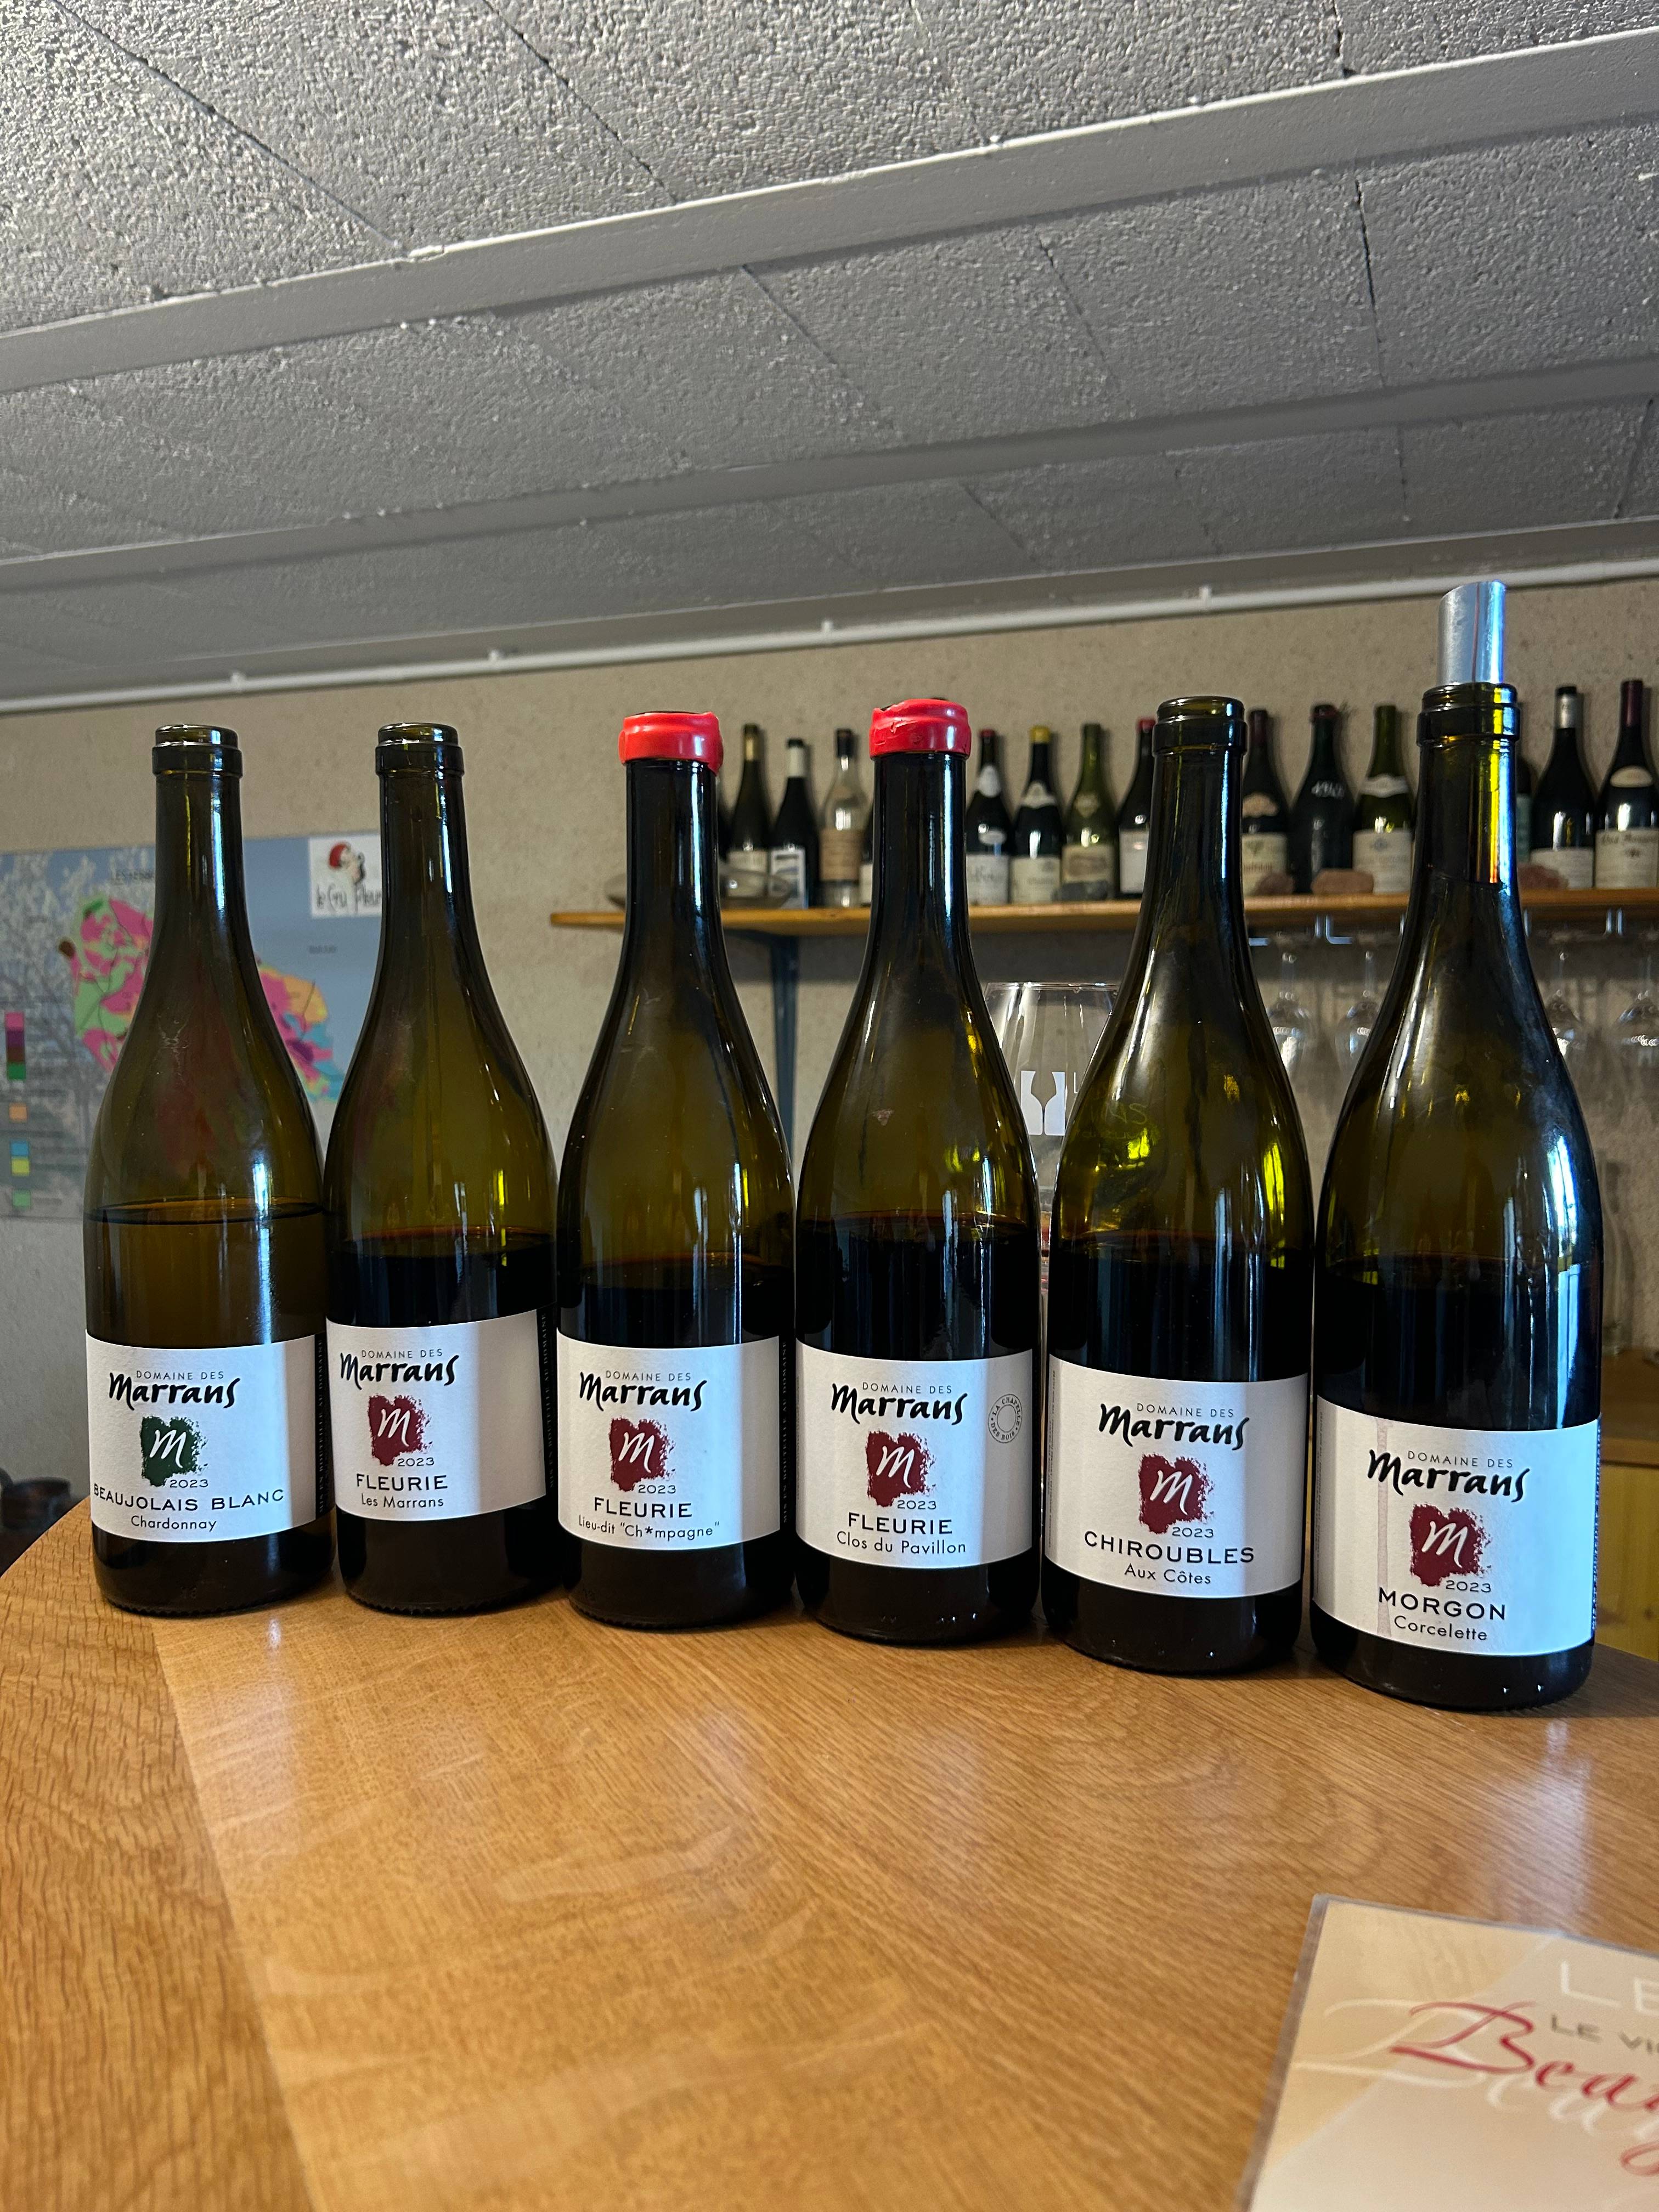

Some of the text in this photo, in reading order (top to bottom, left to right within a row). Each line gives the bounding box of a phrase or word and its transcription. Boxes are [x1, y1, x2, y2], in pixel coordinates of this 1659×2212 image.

[362, 1348, 442, 1359] DOMAINE DES
[136, 1370, 224, 1380] DOMAINE DES
[340, 1352, 459, 1389] Marrans
[605, 1371, 691, 1381] DOMAINE DES
[109, 1373, 240, 1410] Marrans
[579, 1372, 707, 1412] Marrans
[862, 1382, 952, 1394] DOMAINE DES
[831, 1384, 968, 1425] Marrans
[992, 1397, 1021, 1426] LA CHAPELLE
[1136, 1403, 1234, 1417] DOMAINE DES
[991, 1422, 1015, 1440] DES BOIS
[1099, 1403, 1249, 1450] Marrans
[397, 1458, 435, 1466] 2023
[1407, 1450, 1513, 1469] DOMAINE DES
[170, 1479, 208, 1488] 2023
[356, 1473, 448, 1491] FLEURIE
[1367, 1448, 1530, 1503] Marrans
[94, 1484, 284, 1511] BEAUJOLAIS BLANC
[638, 1484, 676, 1494] 2023
[360, 1493, 444, 1508] Les Marrans
[594, 1497, 692, 1517] FLEURIE
[897, 1500, 936, 1510] 2023
[131, 1515, 217, 1532] Chardonnay
[579, 1515, 615, 1534] Lieu-dit
[848, 1513, 952, 1534] FLEURIE
[1172, 1527, 1214, 1538] 2023
[837, 1531, 966, 1555] Clos du Pavillon
[1084, 1531, 1255, 1564] CHIROUBLES
[1124, 1563, 1211, 1585] Aux Côtes
[1445, 1579, 1492, 1593] 2023
[1378, 1586, 1506, 1621] MORGON
[1394, 1615, 1487, 1641] Corcelette
[1551, 2015, 1659, 2055] LE VI
[1389, 2001, 1659, 2176] Bea
